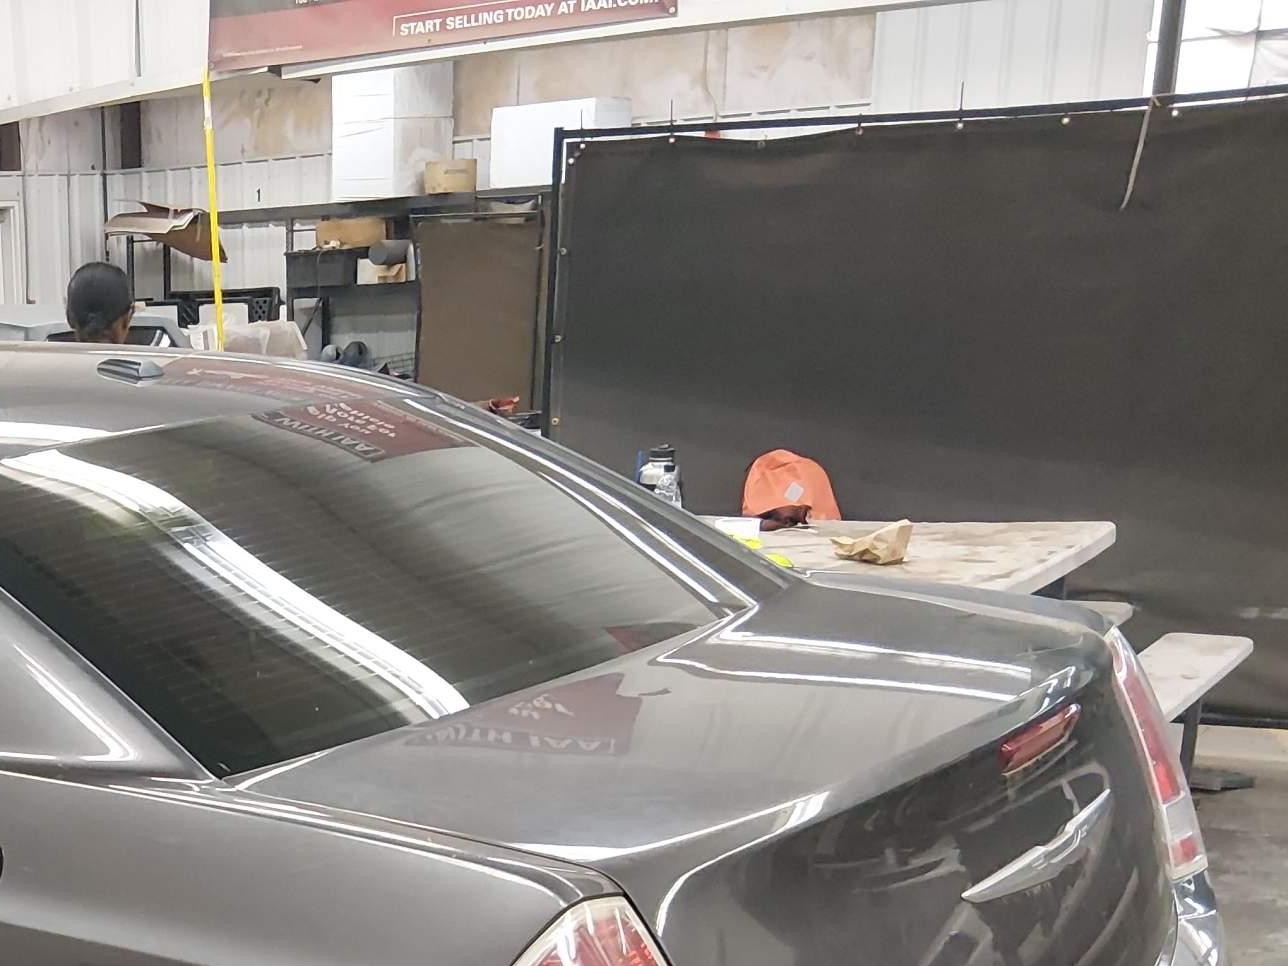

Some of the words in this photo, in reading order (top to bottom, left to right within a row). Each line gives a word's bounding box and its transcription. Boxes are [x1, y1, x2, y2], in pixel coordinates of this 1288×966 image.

[399, 18, 442, 36] START
[446, 12, 504, 30] SELLING
[505, 3, 554, 22] TODAY
[558, 1, 577, 15] AT
